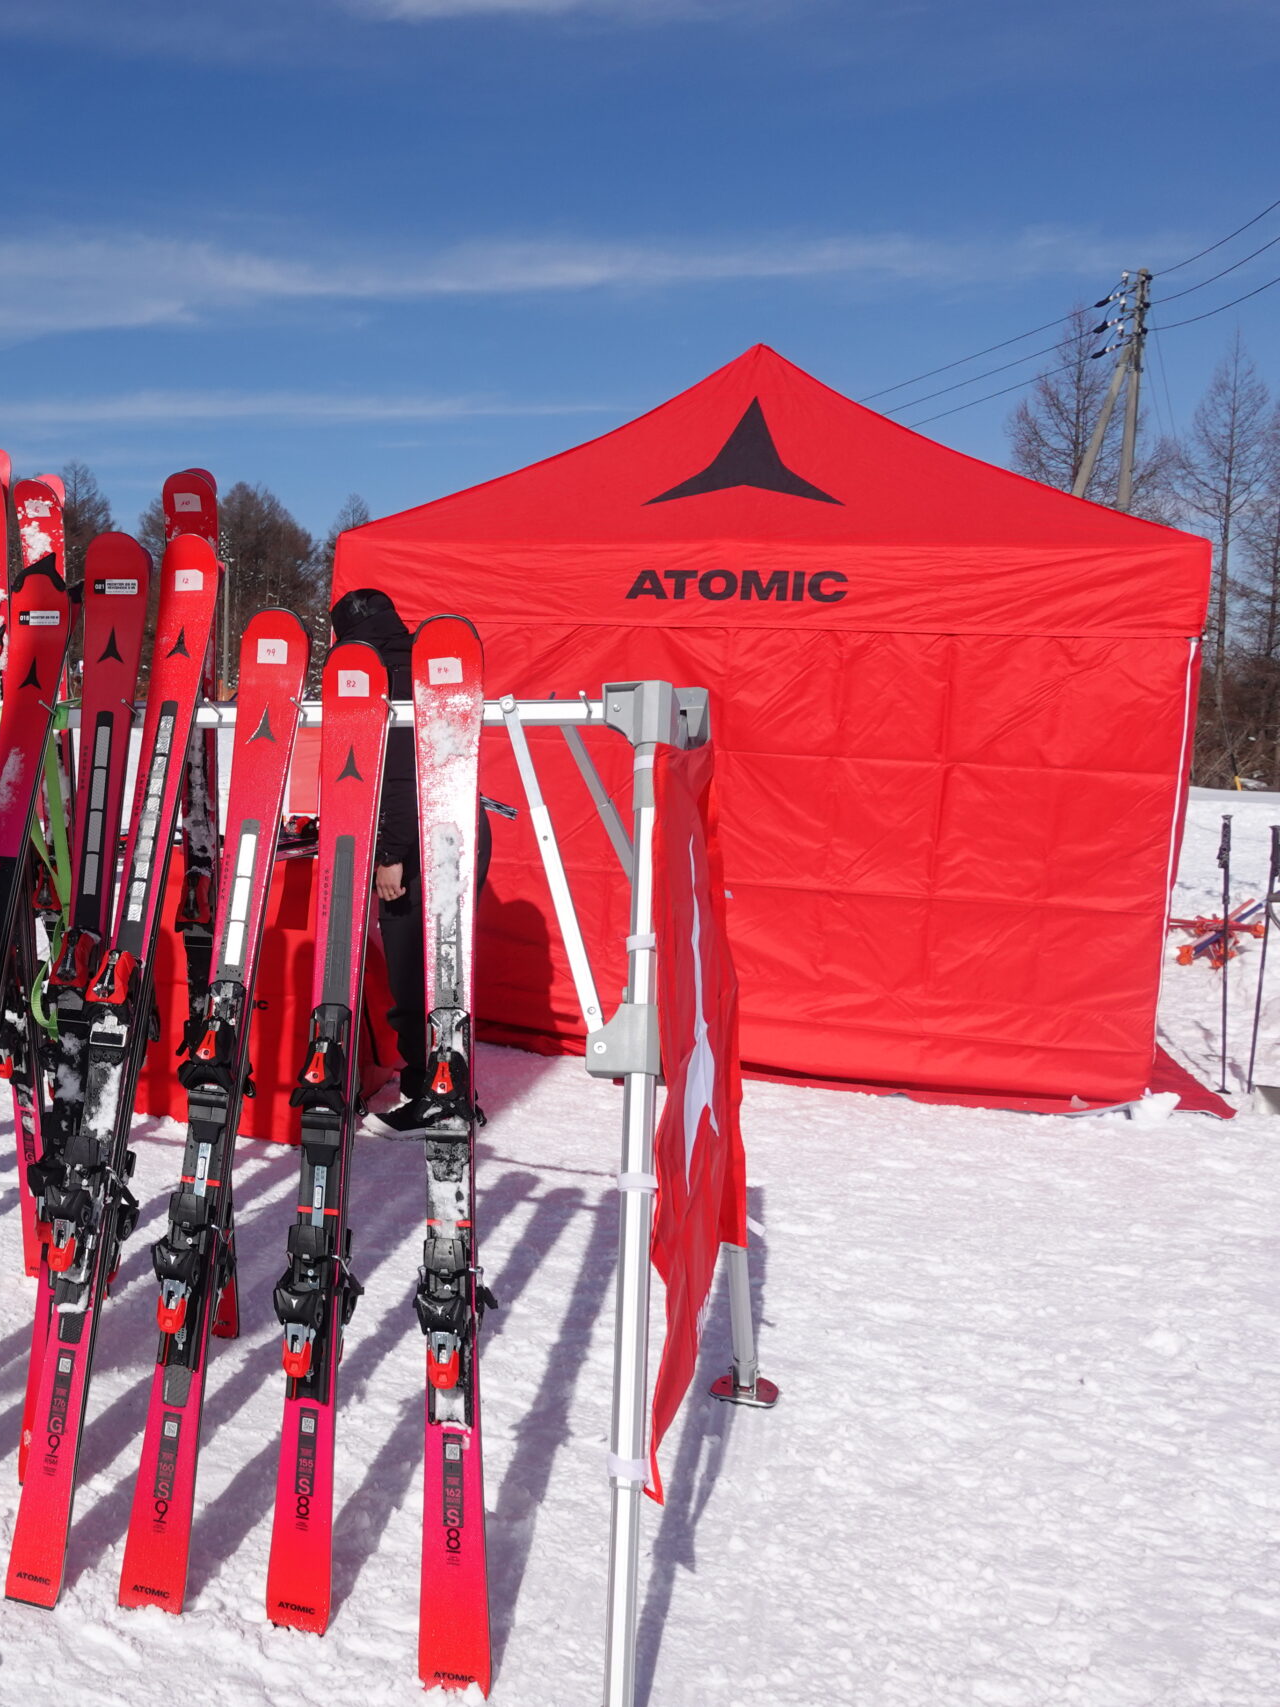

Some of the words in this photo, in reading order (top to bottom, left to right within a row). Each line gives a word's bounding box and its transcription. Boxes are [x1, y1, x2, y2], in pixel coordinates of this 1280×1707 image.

[625, 569, 849, 603] ATOMIC
[346, 679, 357, 689] 82
[53, 1398, 66, 1408] 176
[159, 1462, 174, 1473] 160
[298, 1458, 313, 1467] 155
[445, 1488, 461, 1498] 162
[16, 1570, 51, 1586] ATOMIC
[132, 1583, 170, 1599] ATOMIC
[277, 1600, 316, 1615] ATOMIC
[433, 1670, 475, 1684] ATOMIC
